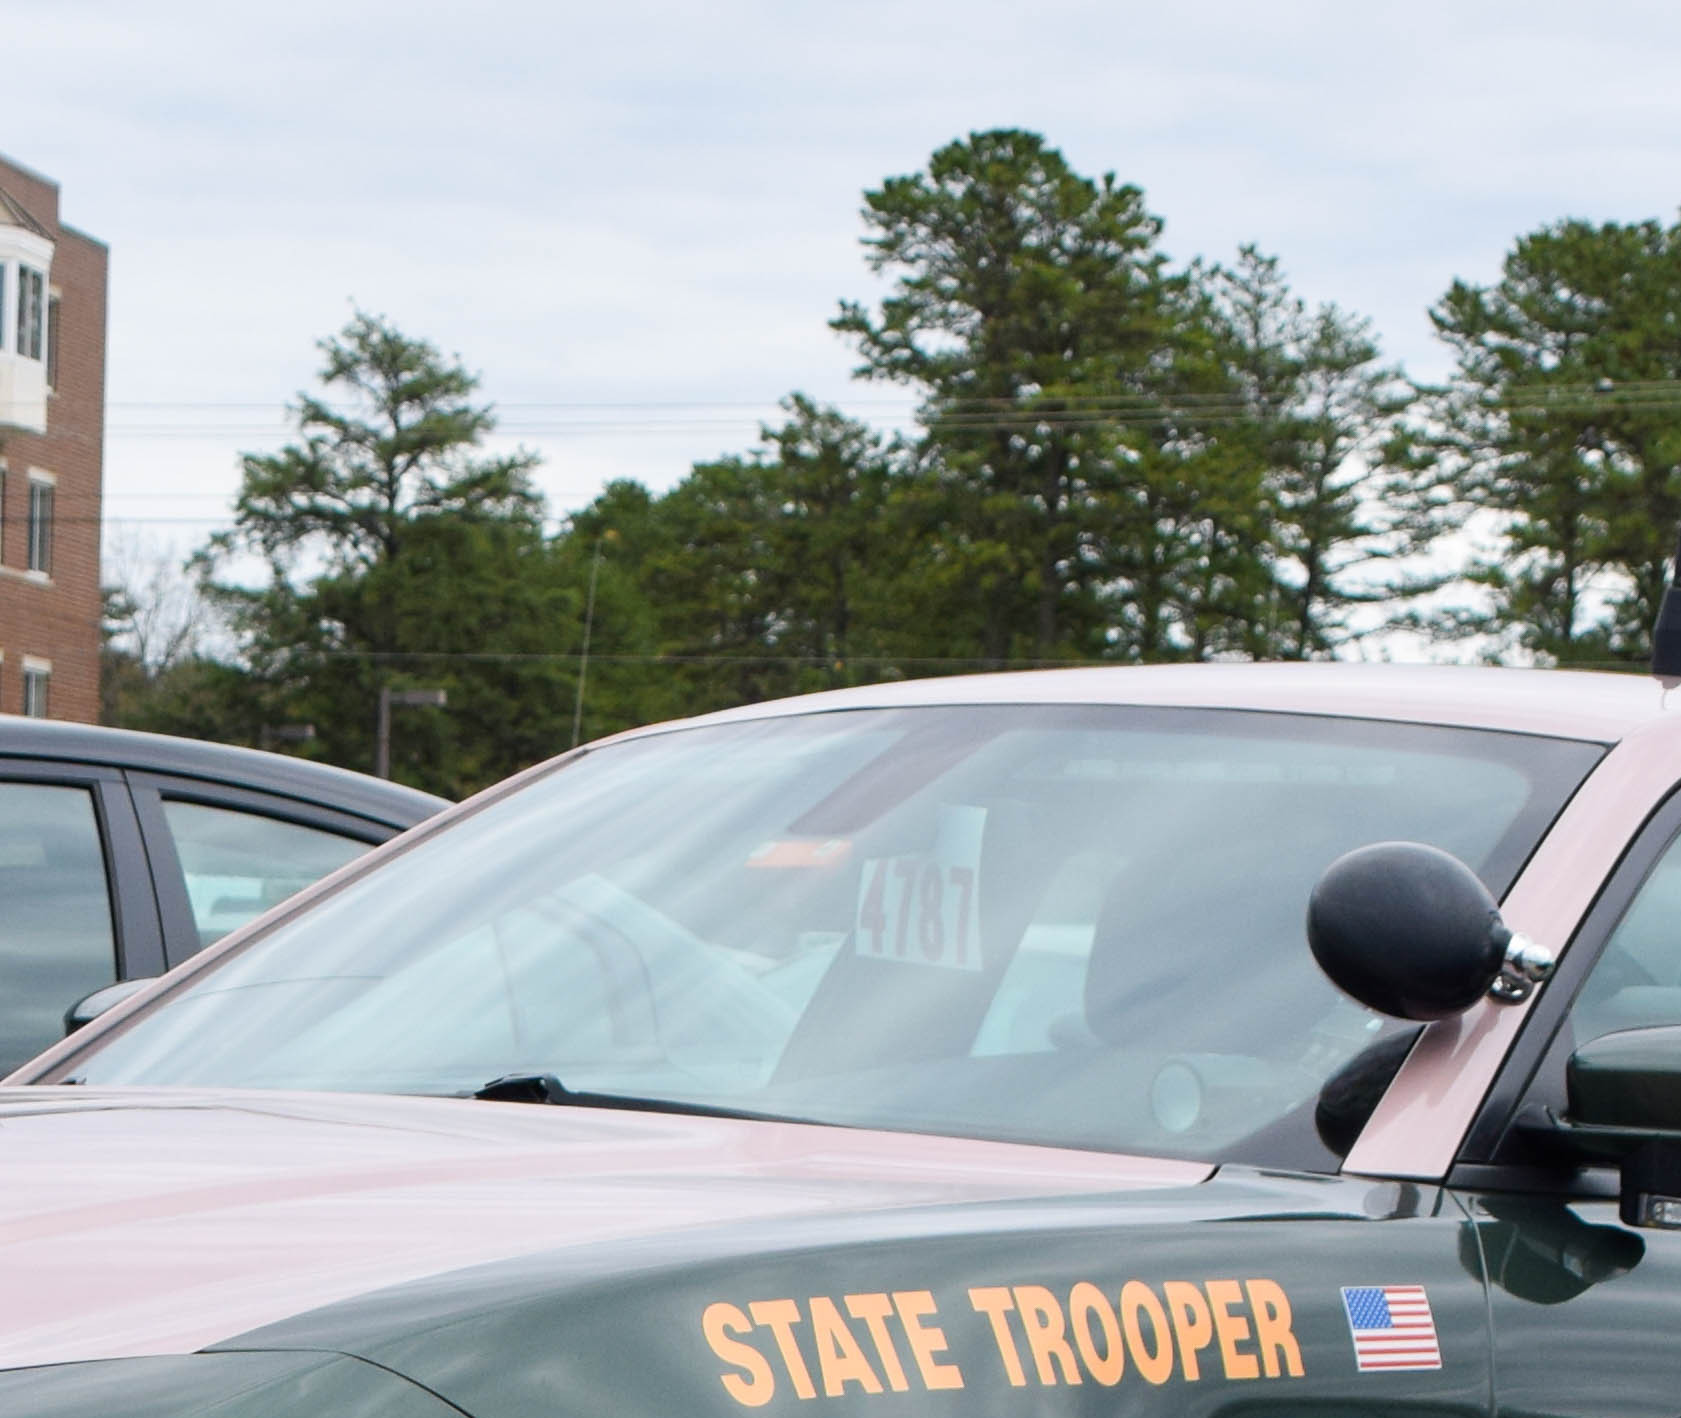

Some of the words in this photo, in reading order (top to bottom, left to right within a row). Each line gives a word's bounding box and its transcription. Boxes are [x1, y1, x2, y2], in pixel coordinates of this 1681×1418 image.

[860, 860, 974, 964] 4787
[702, 1290, 964, 1407] STATE
[968, 1279, 1305, 1387] TROOPER
